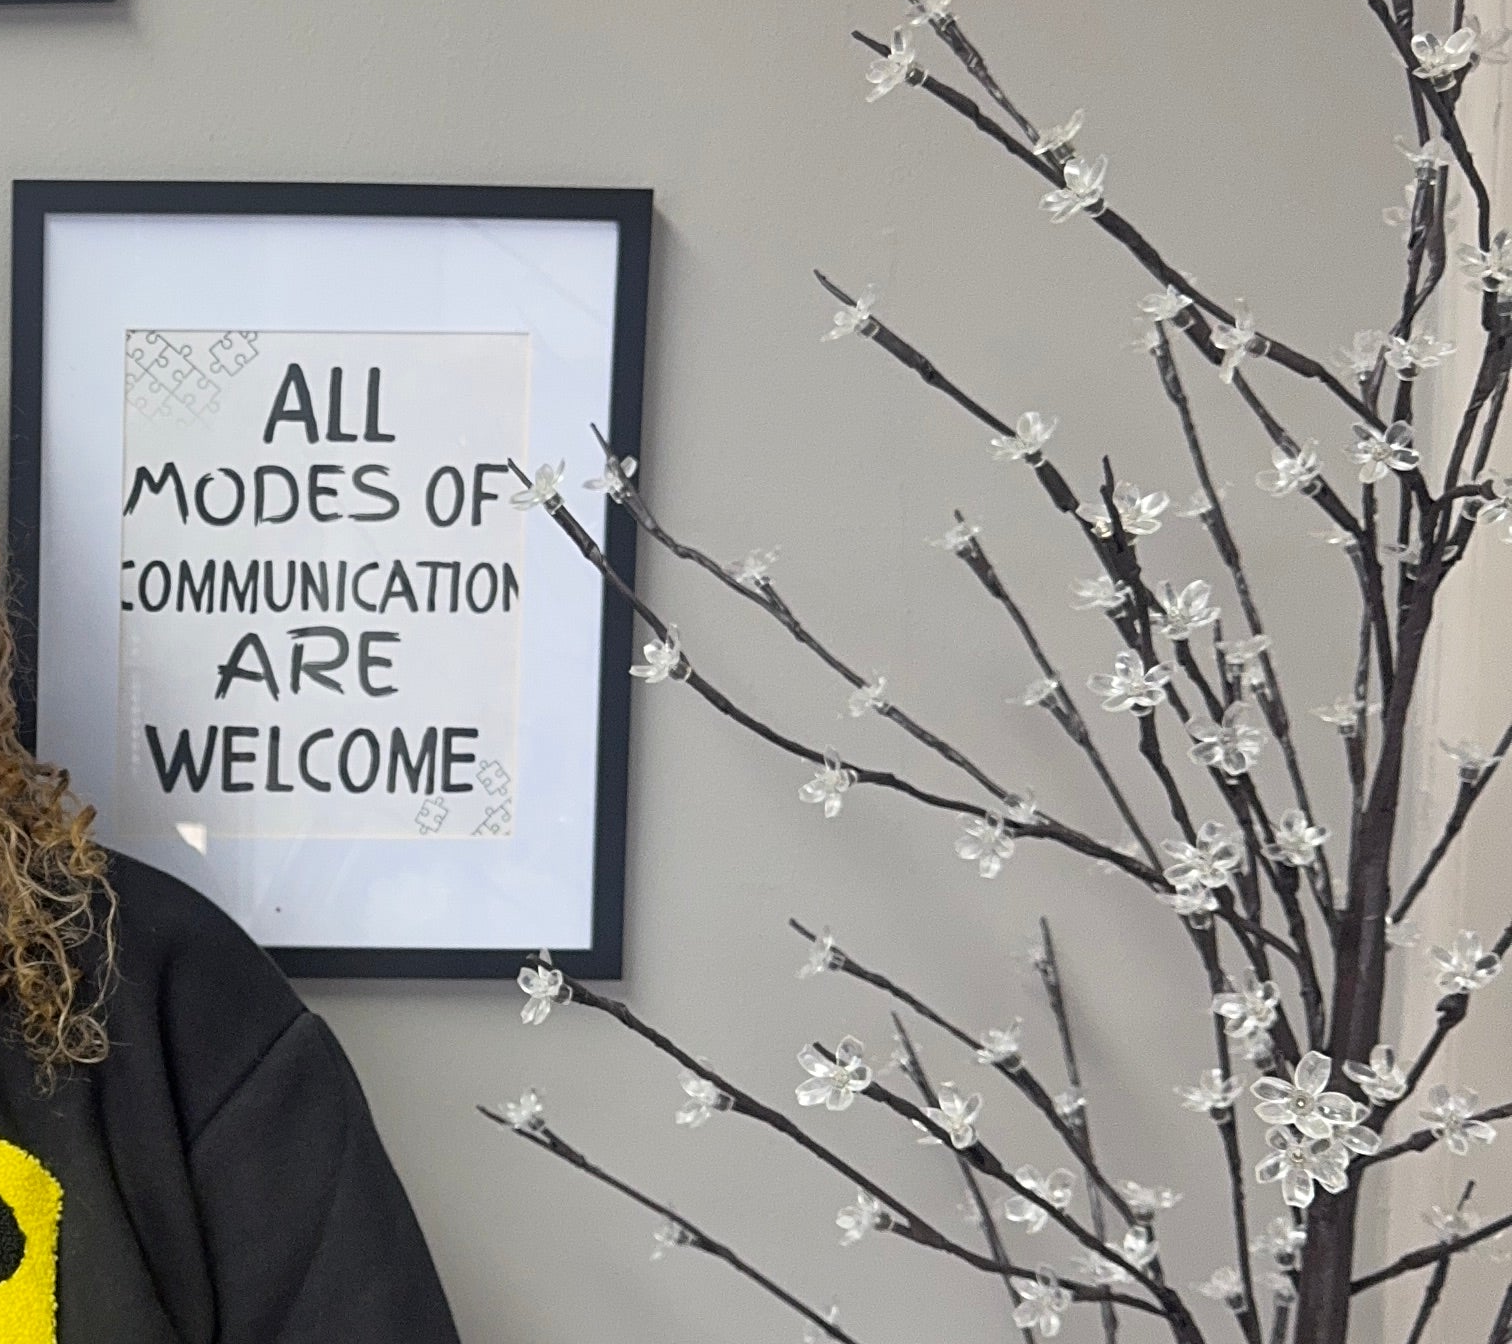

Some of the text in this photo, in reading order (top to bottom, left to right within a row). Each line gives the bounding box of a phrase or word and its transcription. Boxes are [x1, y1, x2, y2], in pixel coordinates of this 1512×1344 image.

[263, 363, 395, 444] ALL
[123, 461, 509, 527] MODES OF
[214, 626, 402, 701] ARE
[145, 725, 479, 794] WELCOME
